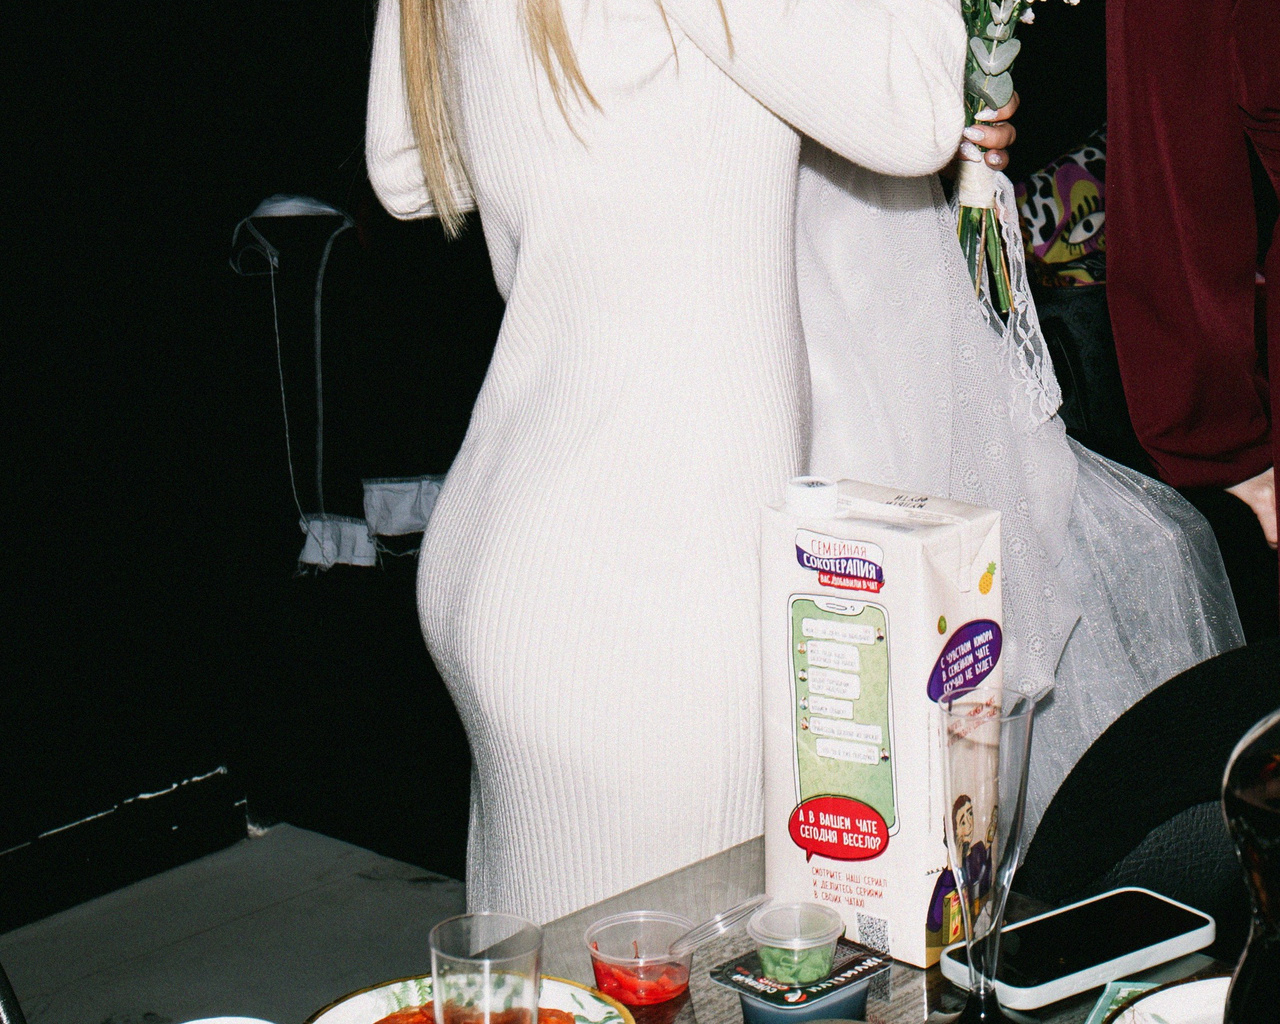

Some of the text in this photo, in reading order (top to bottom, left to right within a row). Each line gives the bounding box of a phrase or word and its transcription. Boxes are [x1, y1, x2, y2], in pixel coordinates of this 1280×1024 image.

[811, 539, 867, 557] СЕМЕЙНАЯ
[803, 552, 877, 580] СОКОТЕРАПИЯ
[940, 656, 945, 669] С
[942, 670, 947, 682] В
[975, 644, 990, 660] ЧАТЕ
[965, 667, 974, 680] НЕ
[799, 808, 878, 834] А В ВАШЕМ ЧАТЕ
[800, 824, 882, 851] СЕГОДНЯ ВЕСЕЛО?
[812, 866, 888, 888] СМОТРИТЕ НАШ СЕРИАЛ
[813, 879, 883, 899] И ДЕЛИТЕСЬ СЕРИЯМИ
[822, 891, 842, 904] СВОИХ
